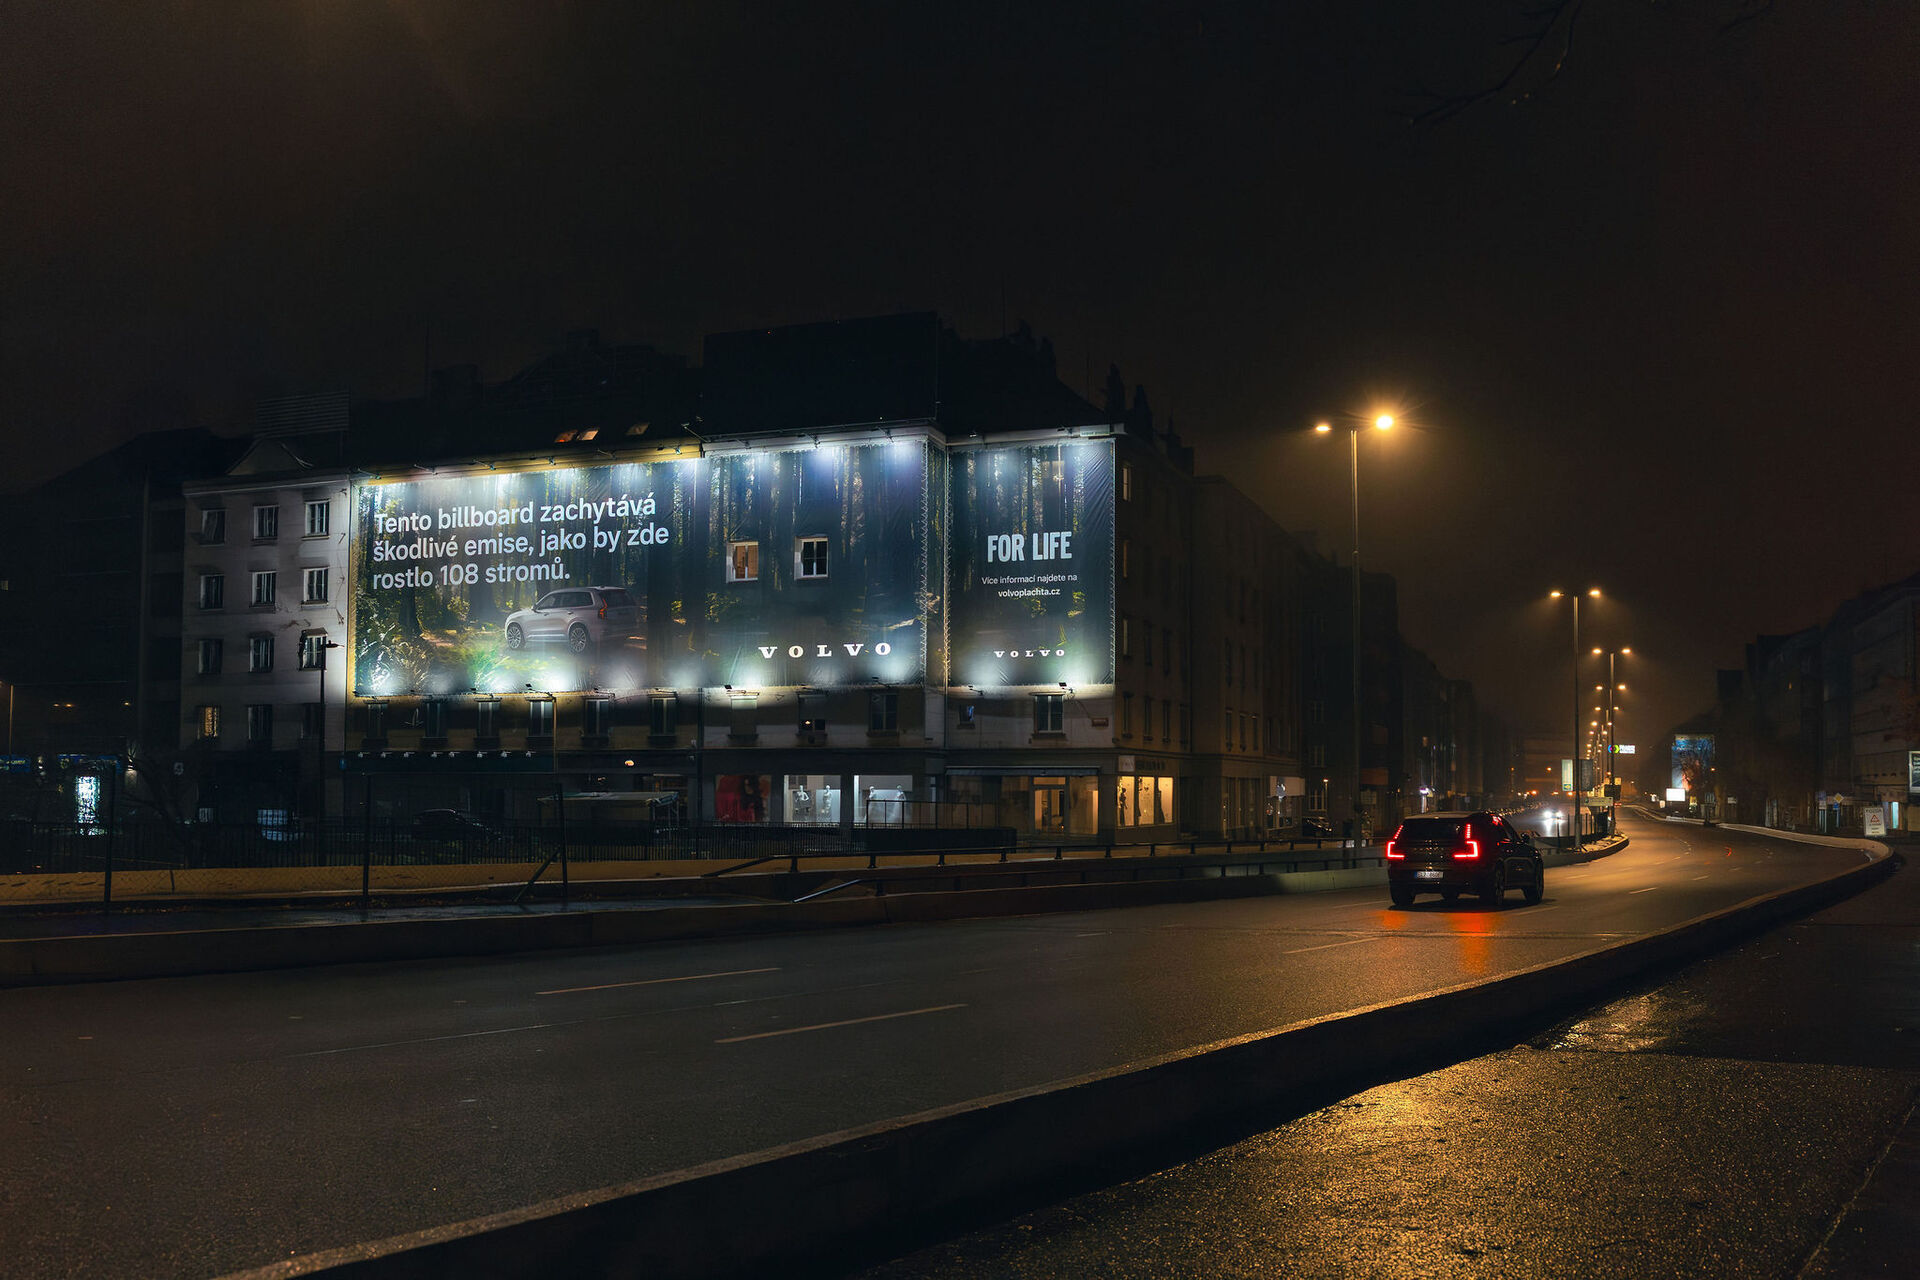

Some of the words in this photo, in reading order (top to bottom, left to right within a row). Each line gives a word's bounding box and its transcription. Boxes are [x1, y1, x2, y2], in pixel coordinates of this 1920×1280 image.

[374, 512, 431, 534] Tento
[438, 502, 534, 530] billboard
[540, 492, 656, 524] zachytává
[373, 534, 458, 562] škodlivé
[464, 532, 534, 557] emise,
[538, 529, 586, 557] jako
[593, 526, 622, 552] by
[627, 523, 669, 546] zde
[987, 533, 1025, 563] FOR
[1032, 531, 1072, 561] LIFE
[373, 564, 433, 590] rostlo
[440, 563, 479, 587] 108
[485, 556, 570, 584] stromů.
[981, 576, 999, 585] Více
[1000, 574, 1036, 584] informací
[1037, 574, 1066, 584] najdete
[1067, 574, 1078, 582] na
[998, 588, 1061, 599] volvoplachta.cz
[758, 642, 892, 660] VOLVO
[994, 649, 1065, 658] VOLVO
